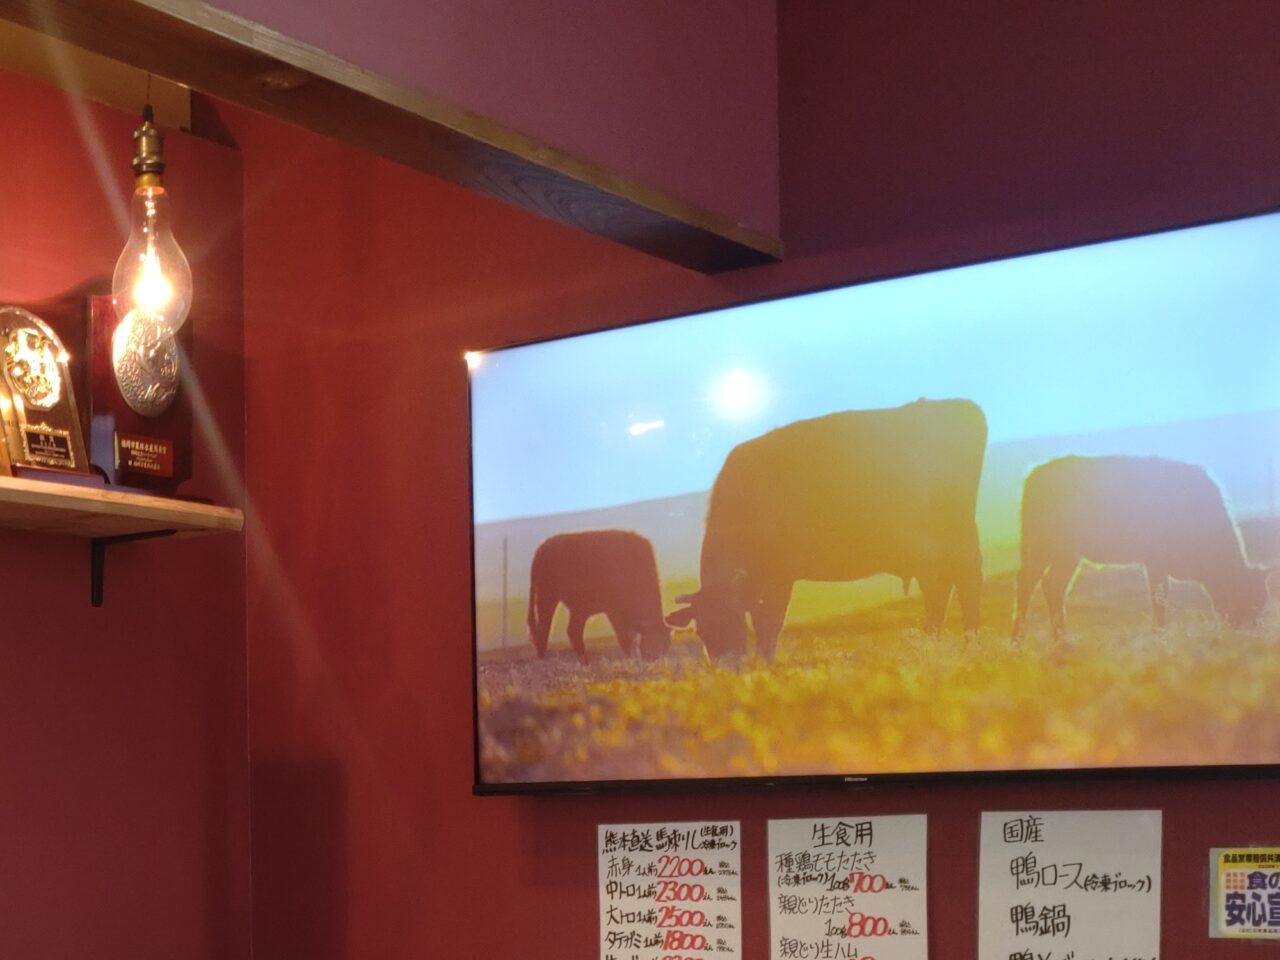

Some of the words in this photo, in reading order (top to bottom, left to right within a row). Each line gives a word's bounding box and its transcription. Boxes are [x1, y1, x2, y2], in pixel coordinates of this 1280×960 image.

[811, 820, 874, 849] 生食用
[1003, 815, 1045, 844] 国産
[657, 855, 705, 878] 2200
[655, 881, 705, 902] 2300
[849, 871, 887, 893] 700
[656, 905, 705, 928] 2500
[847, 912, 889, 938] 800
[1010, 901, 1072, 938] 鴨鍋
[662, 930, 707, 951] 1800
